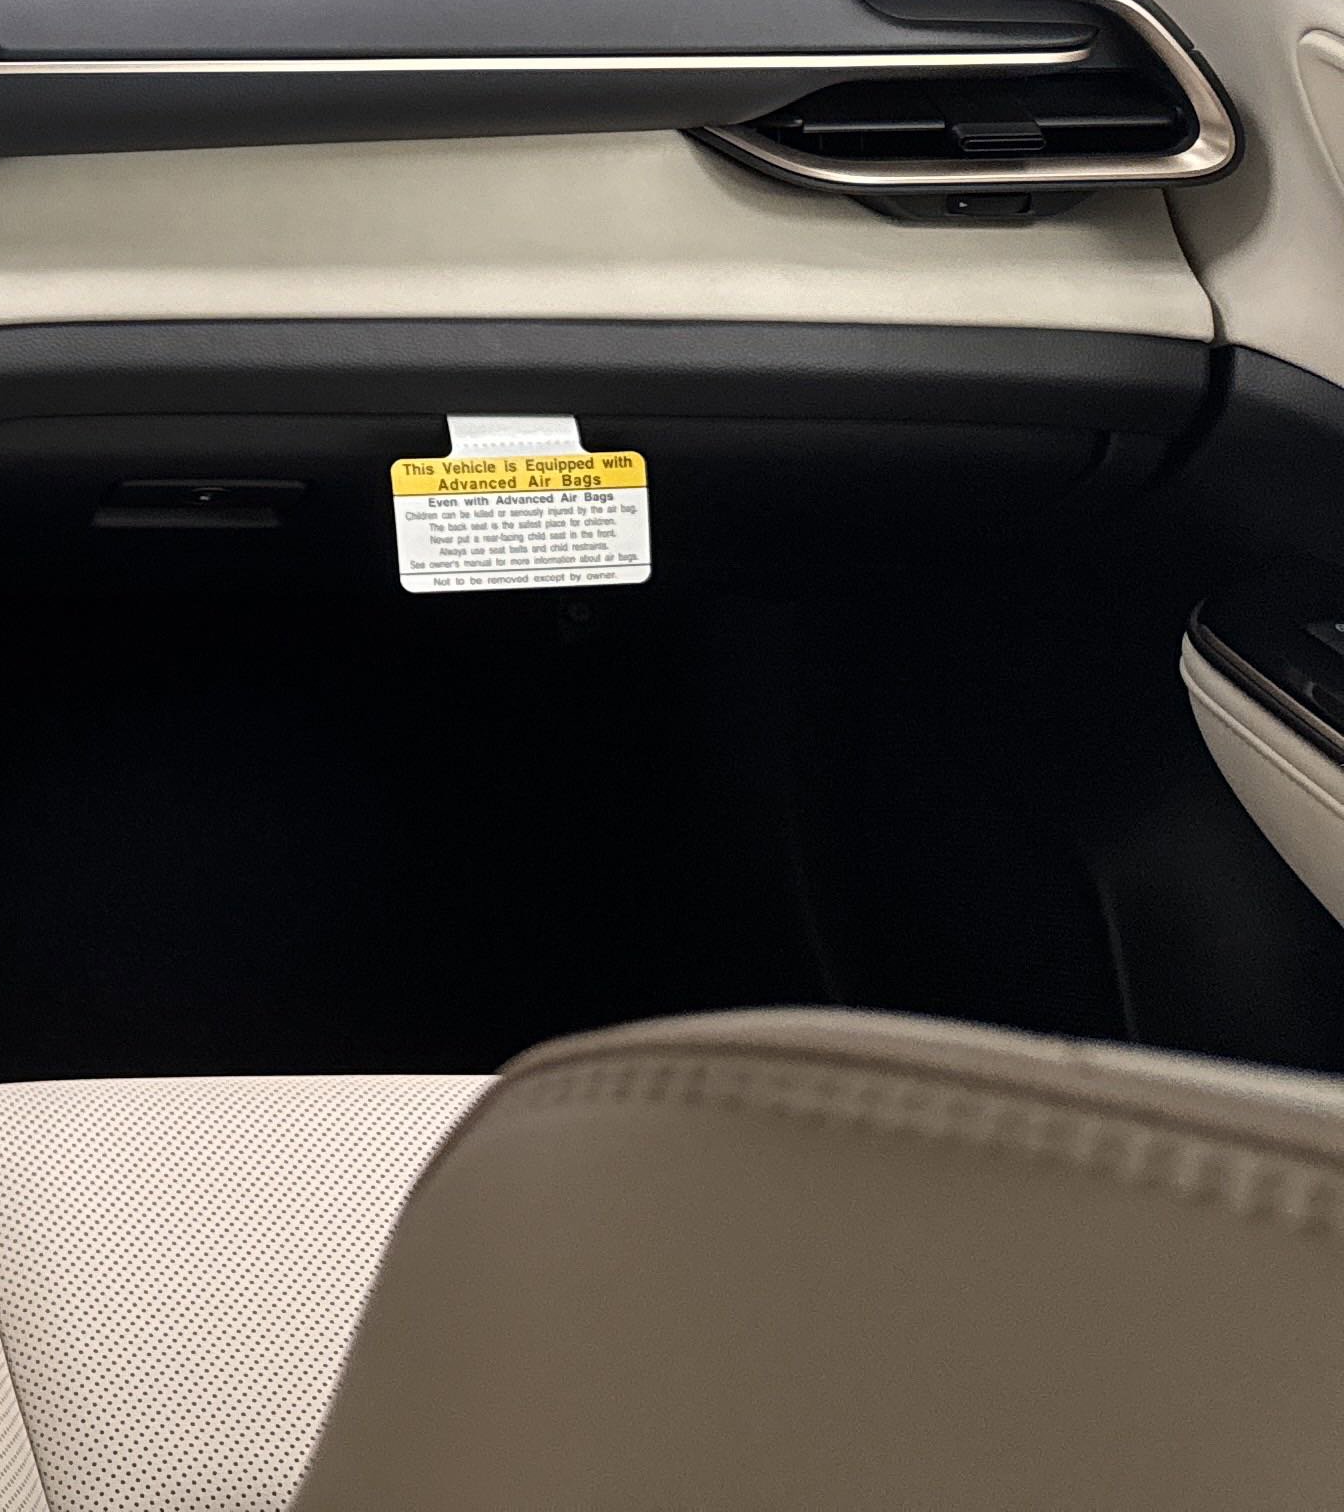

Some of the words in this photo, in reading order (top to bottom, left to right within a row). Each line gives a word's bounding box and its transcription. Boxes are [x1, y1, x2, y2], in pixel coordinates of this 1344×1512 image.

[402, 462, 434, 476] This
[442, 461, 496, 475] Vehicle
[504, 460, 517, 473] is
[525, 457, 594, 474] Equipped
[602, 455, 633, 469] with
[438, 476, 517, 491] Advanced
[528, 474, 551, 488] Air
[562, 473, 601, 487] Bags
[428, 496, 458, 508] Even
[463, 495, 489, 506] with
[495, 493, 554, 505] Advanced
[560, 492, 577, 503] Air
[584, 491, 614, 503] Bags
[433, 577, 450, 586] Not
[455, 577, 465, 585] to
[470, 576, 482, 585] be
[487, 575, 529, 584] removed
[533, 573, 565, 583] except
[569, 572, 581, 581] by
